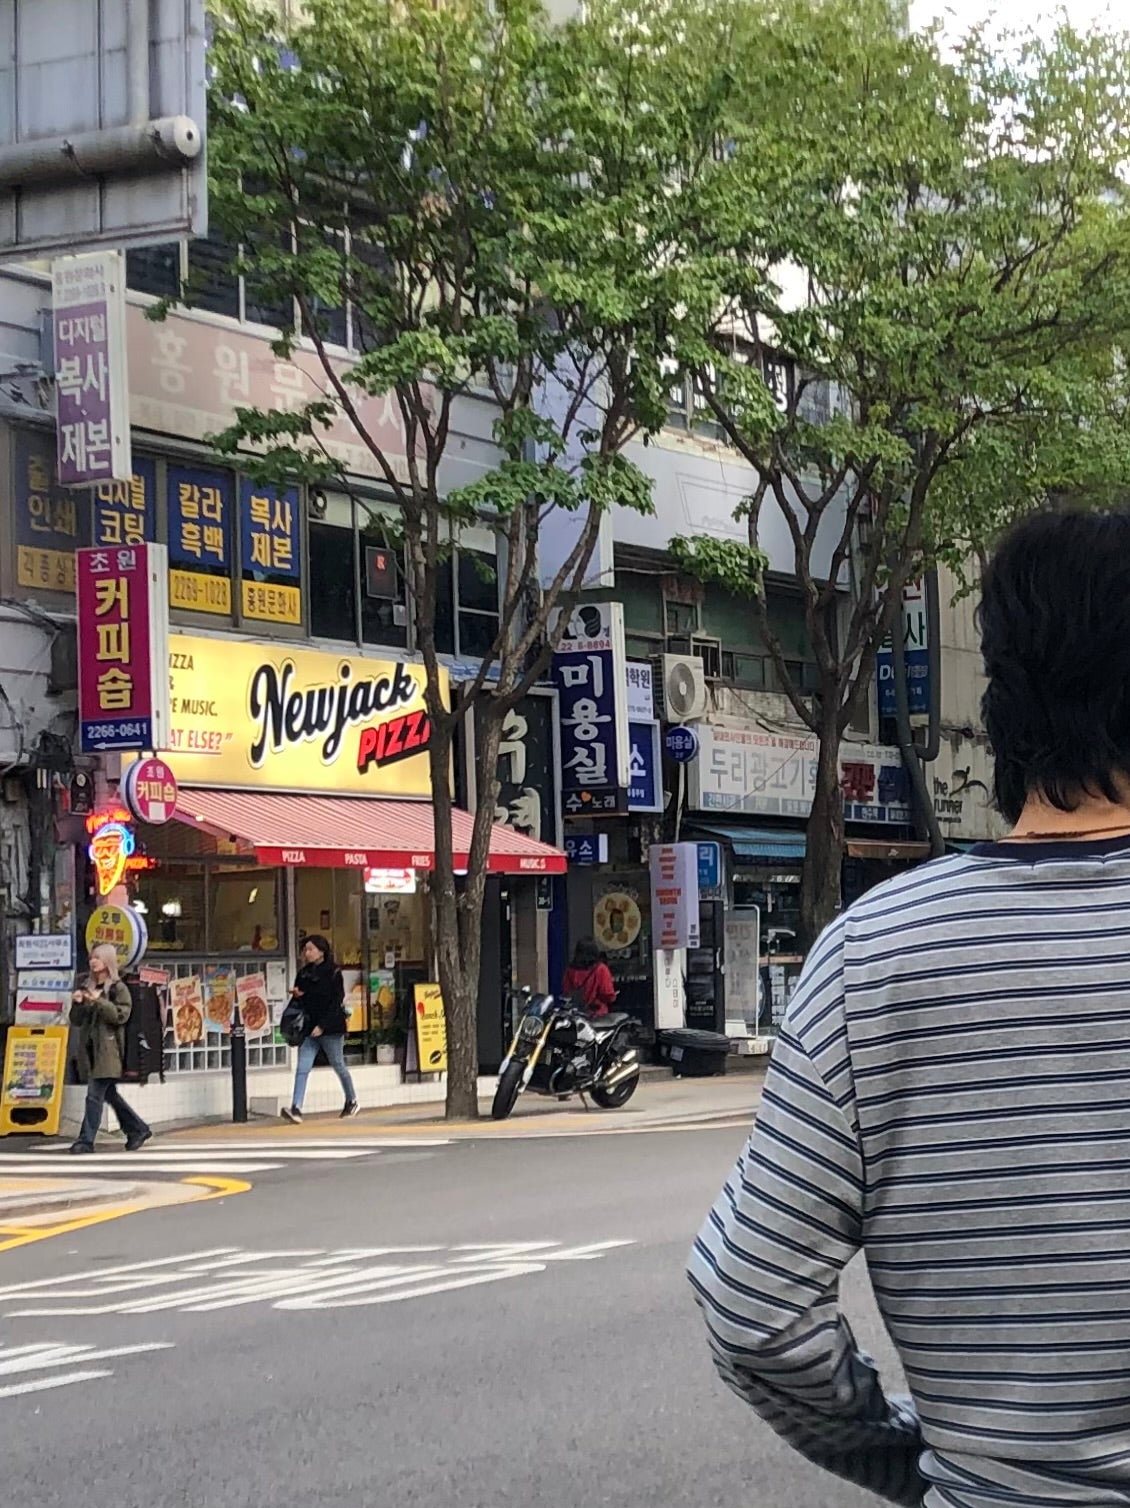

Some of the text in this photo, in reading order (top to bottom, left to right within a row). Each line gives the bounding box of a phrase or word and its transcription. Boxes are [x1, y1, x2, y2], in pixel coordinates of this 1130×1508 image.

[59, 314, 105, 346] 디지털
[58, 352, 107, 405] 복사
[61, 420, 110, 472] 제본
[178, 483, 223, 523] 칼라
[250, 495, 292, 535] 복사
[100, 509, 145, 545] 코팅
[180, 522, 224, 562] 흑백
[89, 549, 136, 573] 초원
[251, 532, 292, 569] 제본
[169, 653, 194, 670] IZZA
[180, 698, 218, 717] MUSIC.
[251, 662, 416, 764] Newjack
[558, 655, 612, 785] 미용실
[87, 723, 148, 740] 2266-0641
[282, 850, 306, 864] PIZZA
[344, 852, 368, 866] PASTA
